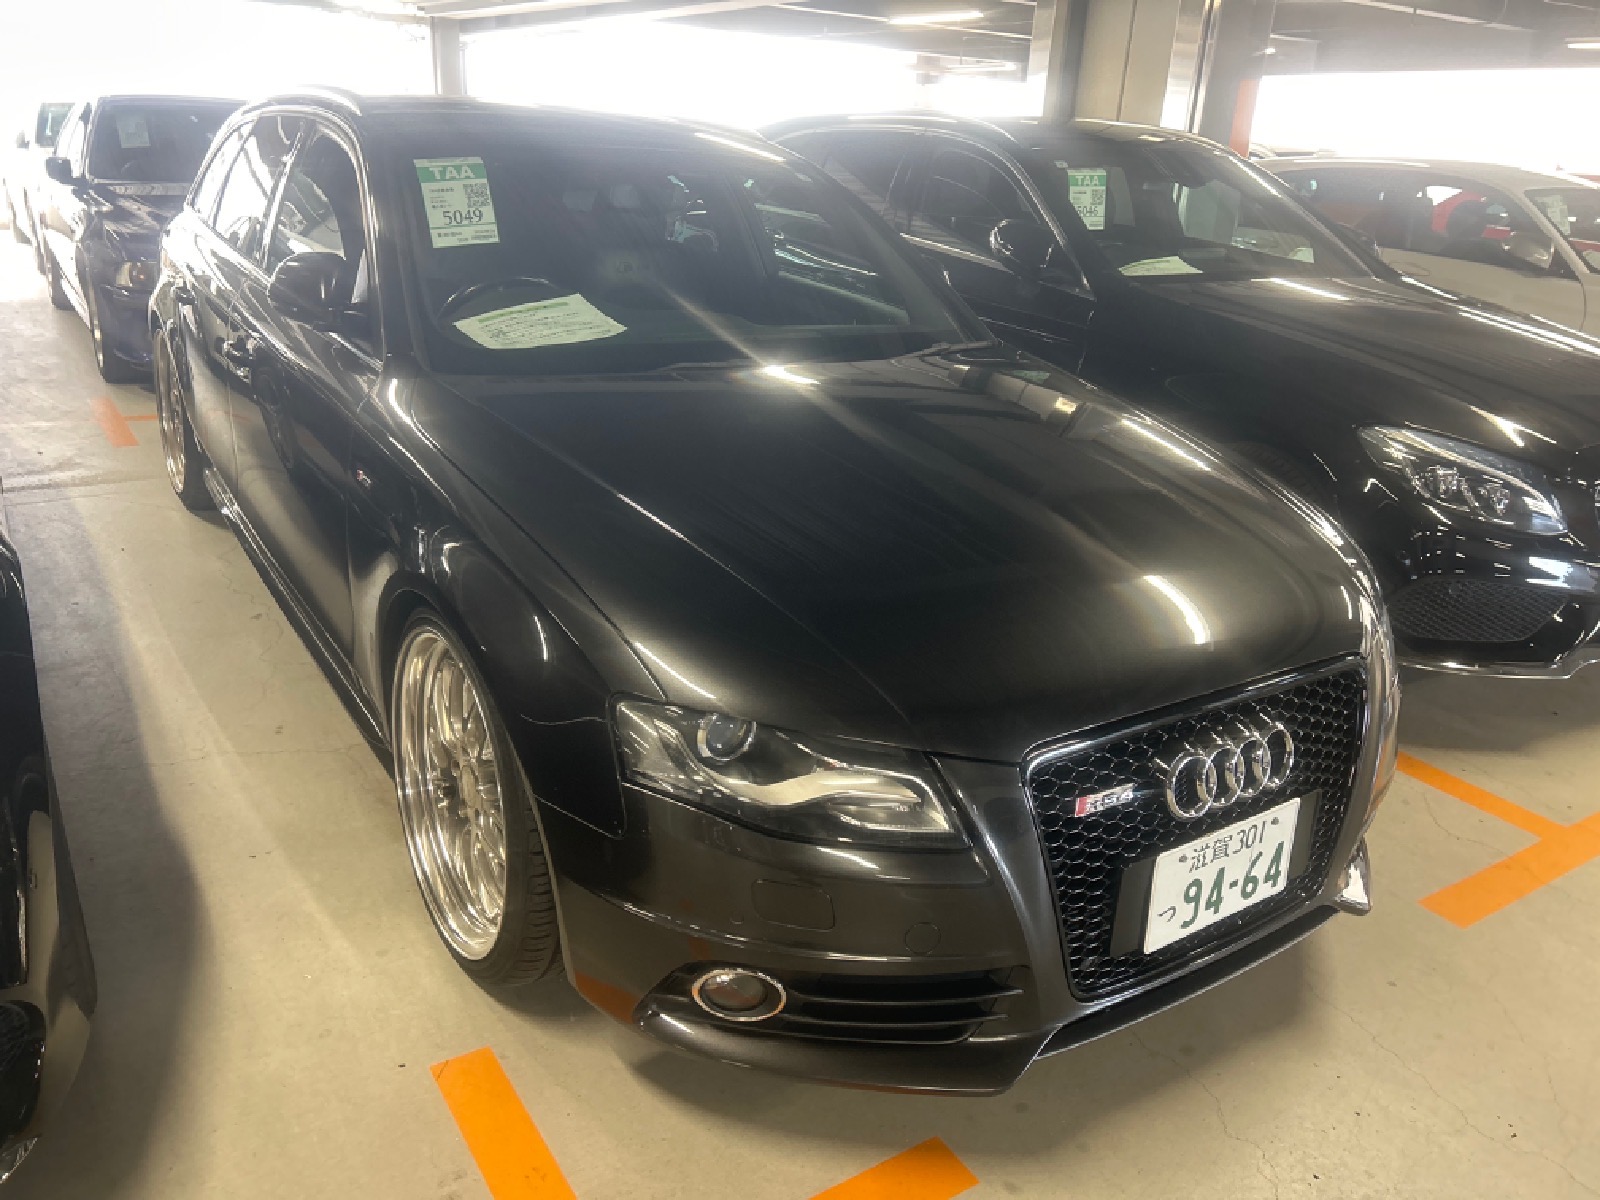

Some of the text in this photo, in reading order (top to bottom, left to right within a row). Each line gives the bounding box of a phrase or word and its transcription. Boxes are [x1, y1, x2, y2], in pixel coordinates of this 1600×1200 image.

[429, 166, 476, 180] TAA
[1075, 175, 1099, 187] TAA
[442, 208, 484, 225] 5049
[1188, 820, 1267, 874] 滋賀 301
[1157, 840, 1286, 930] つ 94-64
